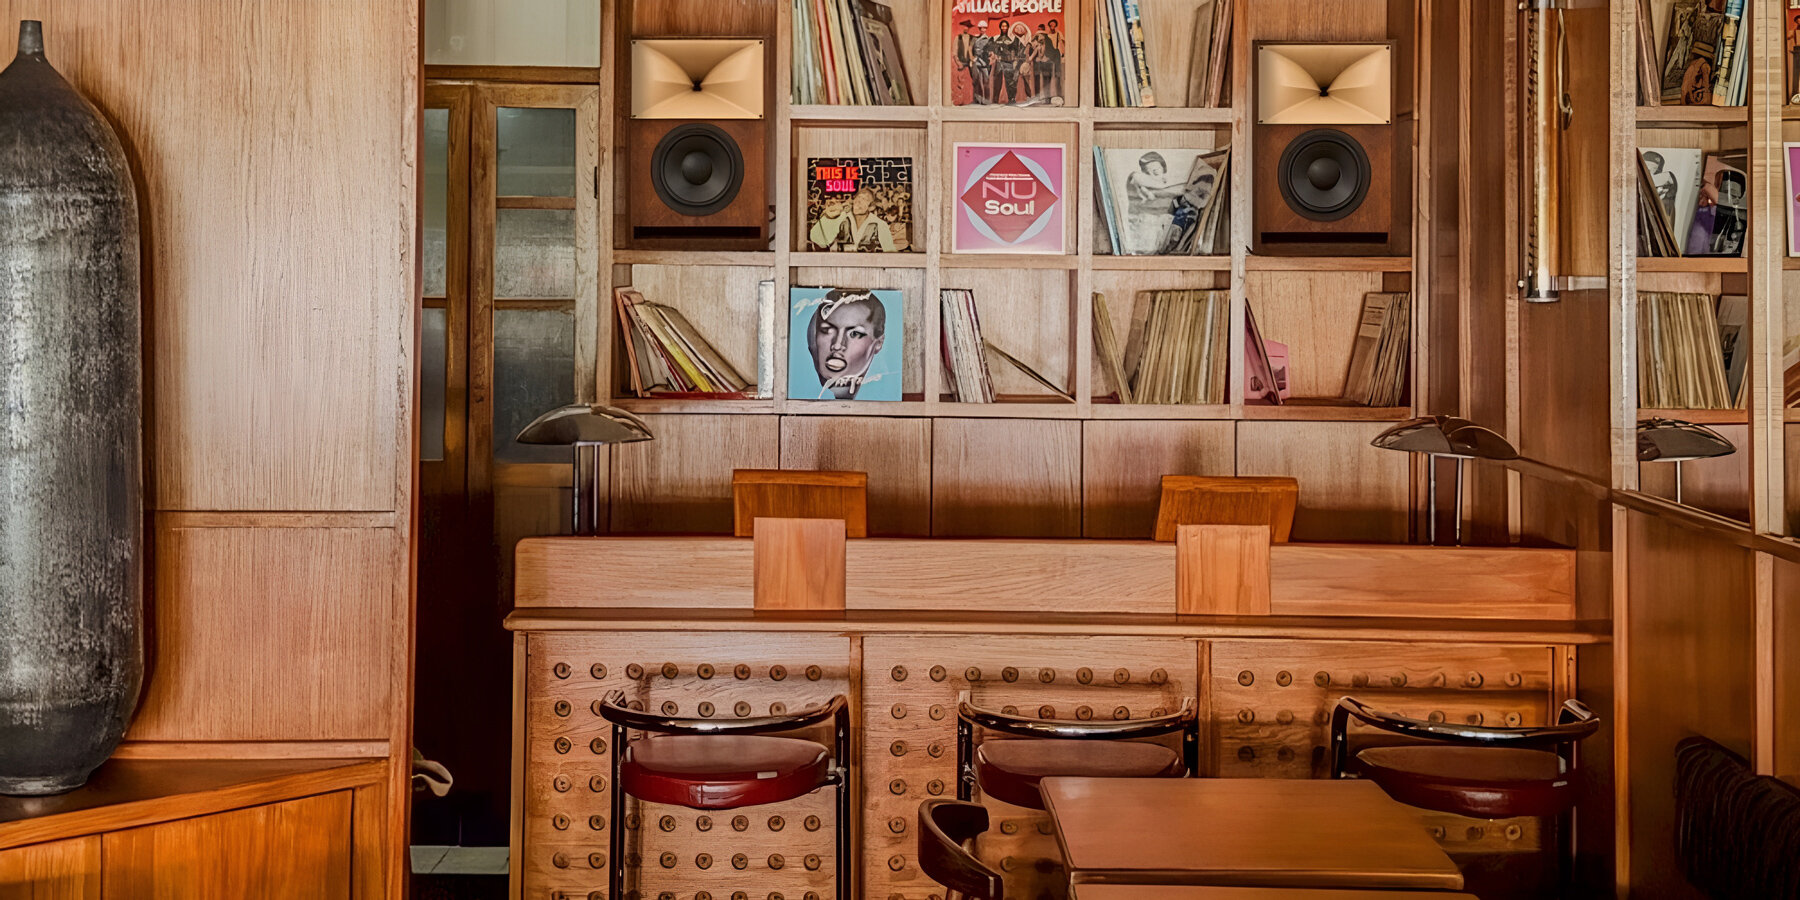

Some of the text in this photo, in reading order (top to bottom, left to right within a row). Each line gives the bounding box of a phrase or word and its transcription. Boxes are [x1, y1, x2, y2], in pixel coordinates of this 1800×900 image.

[1011, 0, 1062, 13] PEOPLE
[816, 167, 860, 180] THIS IS
[826, 180, 856, 192] SOUL
[982, 181, 1037, 199] NU
[984, 200, 1035, 215] Soul
